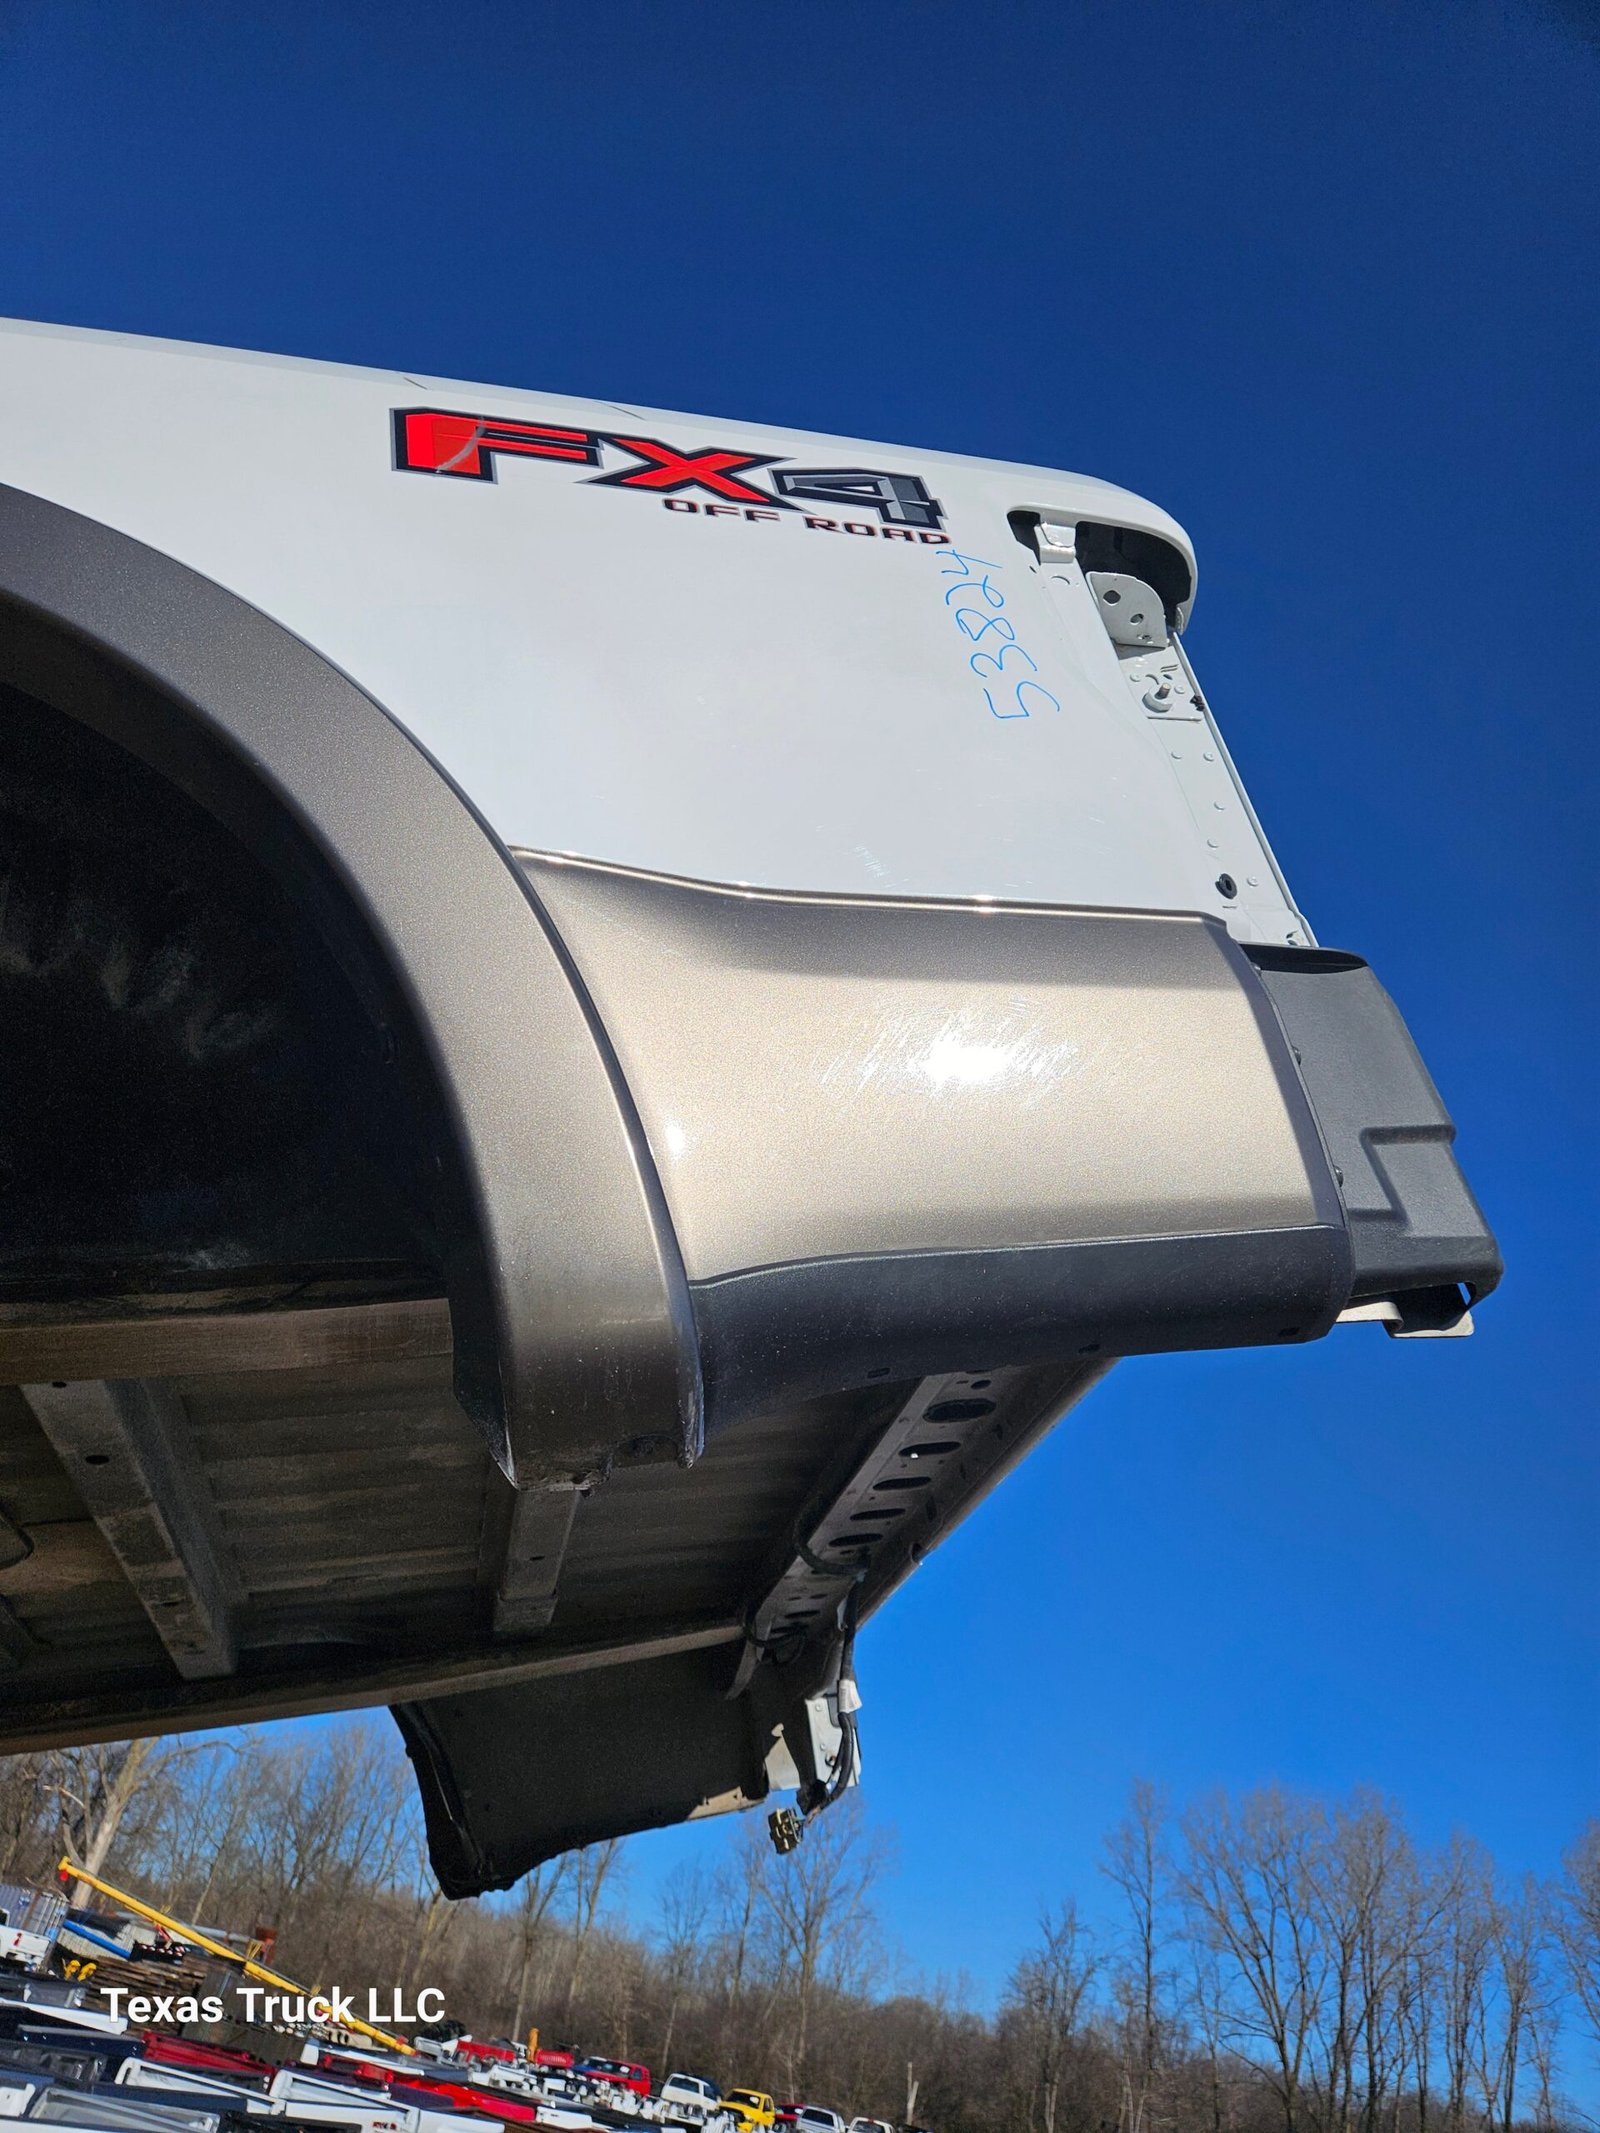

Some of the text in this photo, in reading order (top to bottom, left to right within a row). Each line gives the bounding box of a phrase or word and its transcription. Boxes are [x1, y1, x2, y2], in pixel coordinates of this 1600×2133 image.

[389, 406, 948, 531] FX4
[662, 497, 952, 545] OFF ROAD
[936, 549, 1060, 719] 53824
